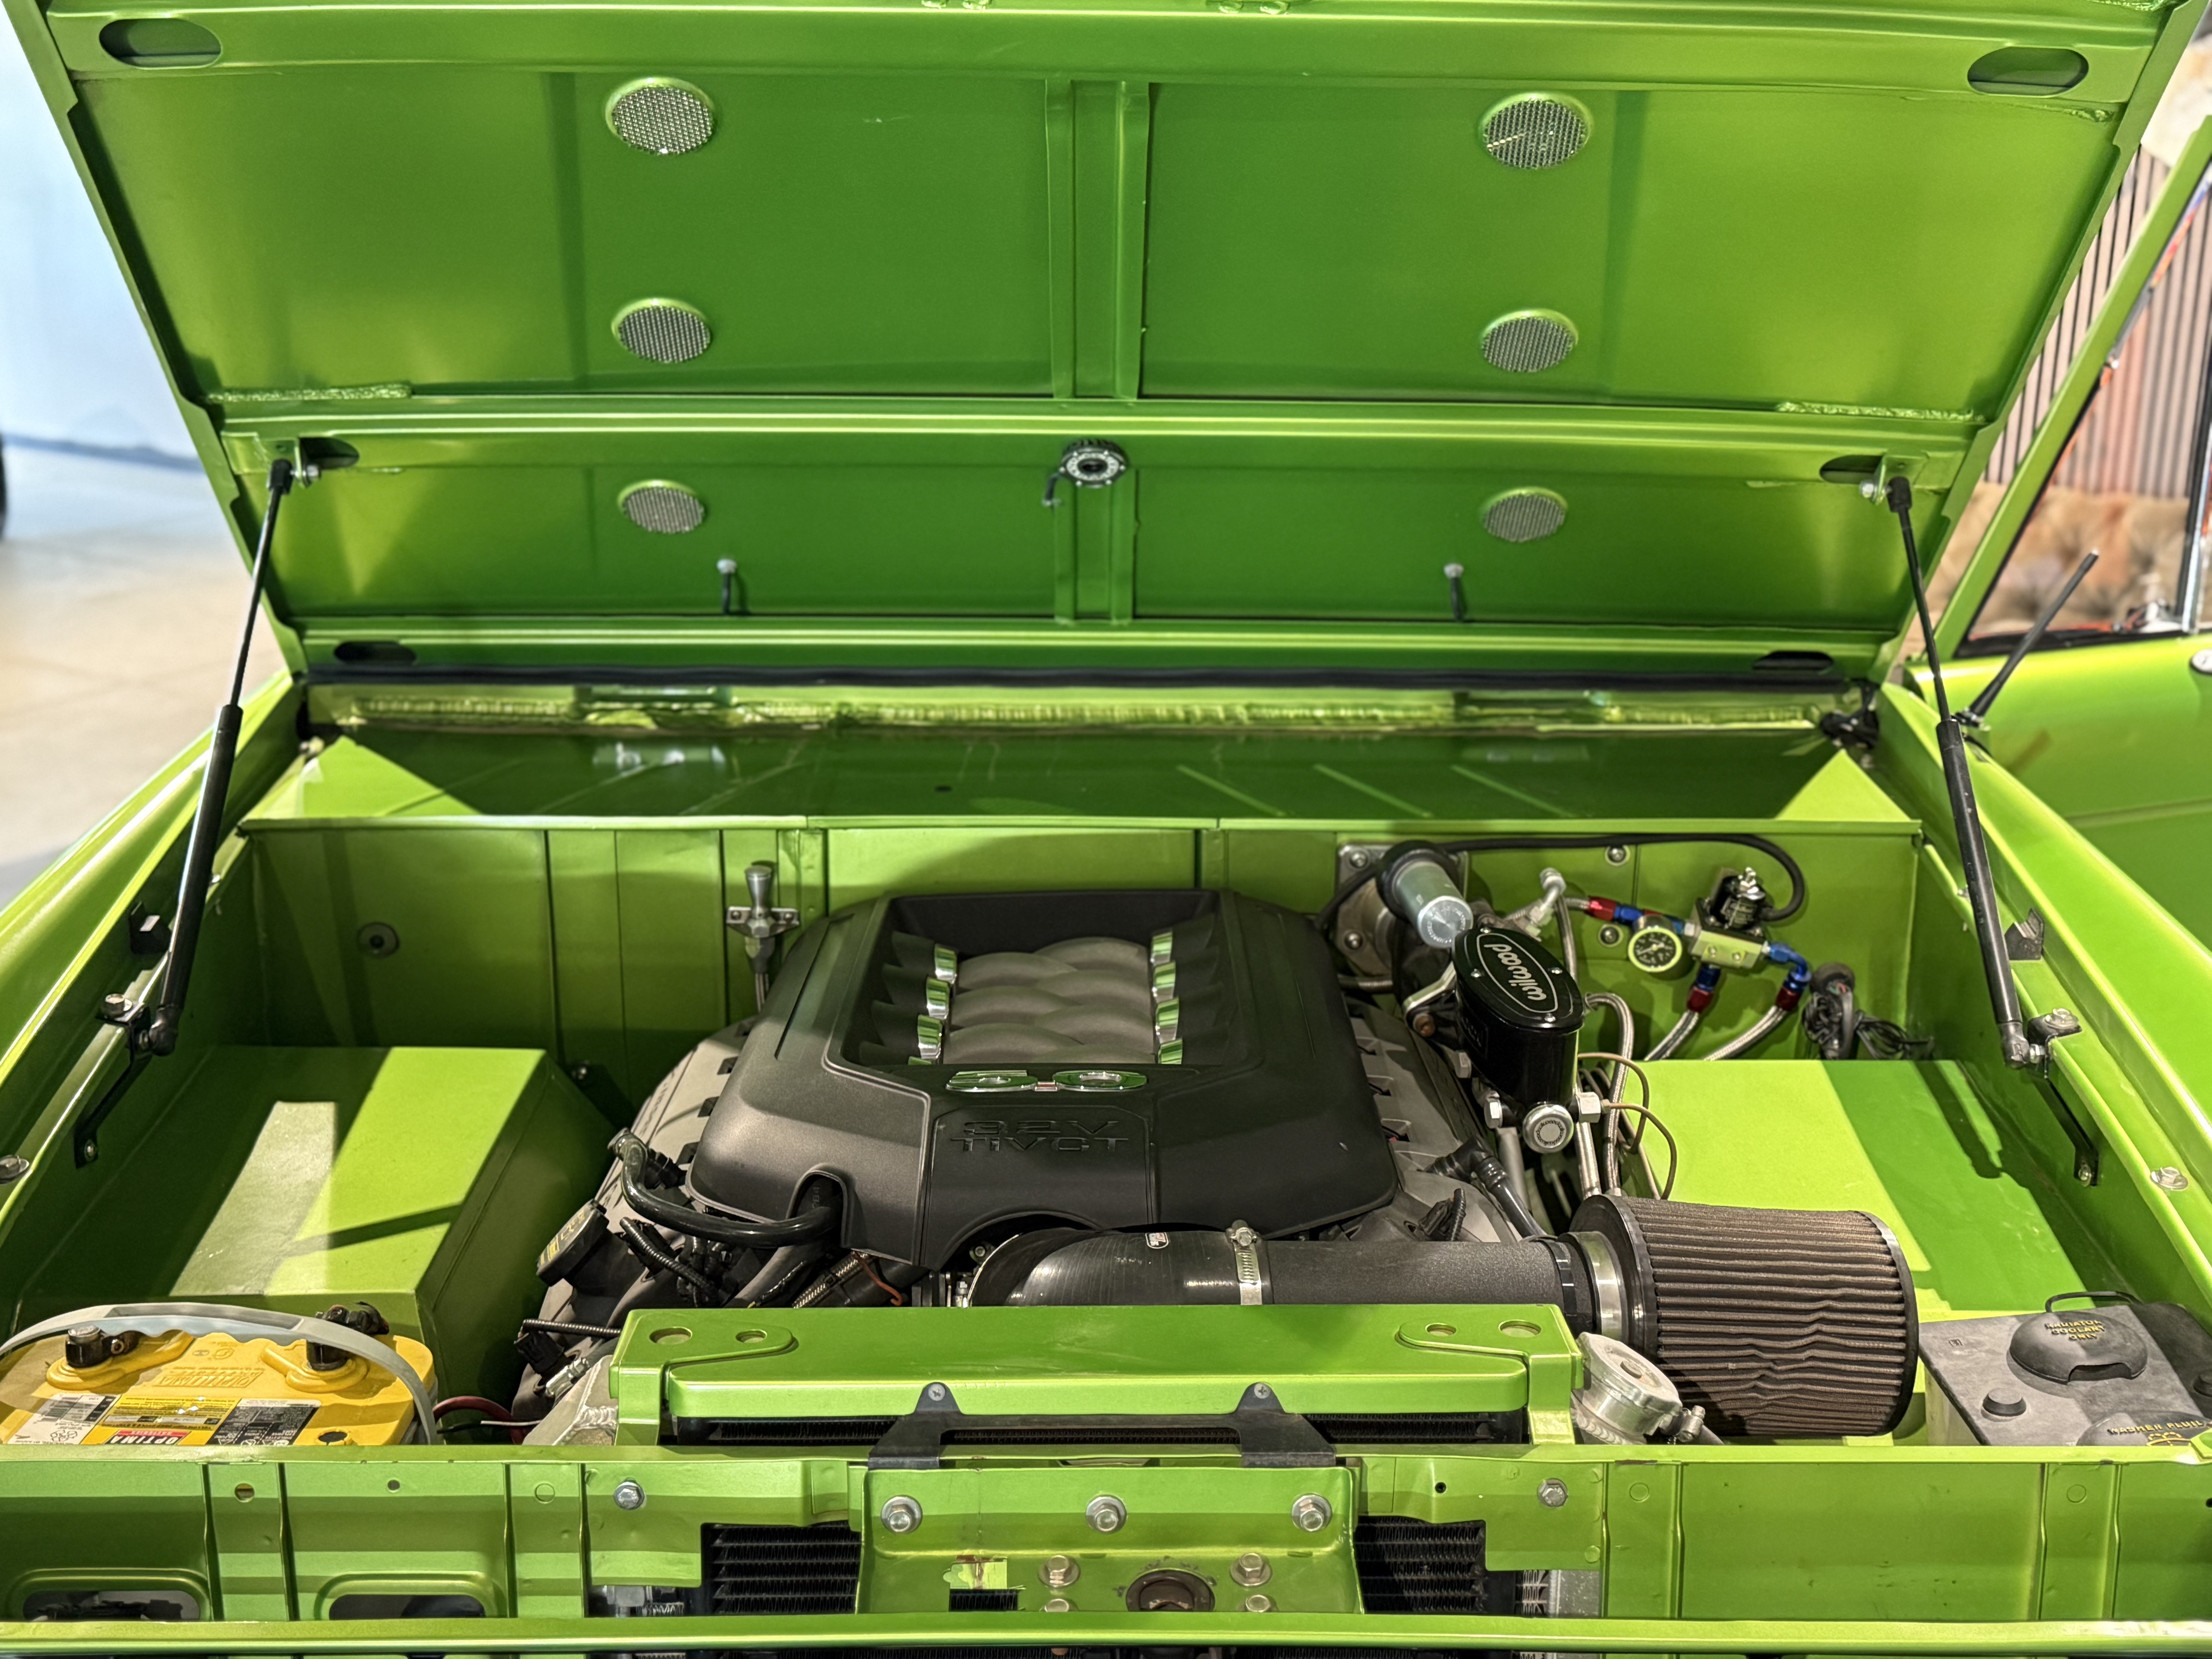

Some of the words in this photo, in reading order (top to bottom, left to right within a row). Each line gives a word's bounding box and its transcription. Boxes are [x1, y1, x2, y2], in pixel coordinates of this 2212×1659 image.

[1484, 944, 1547, 1000] wilwood
[964, 1121, 1119, 1134] 32V
[2051, 1326, 2105, 1334] COOLANT
[2107, 1424, 2163, 1435] WASHER
[110, 1436, 179, 1444] OPTIMA
